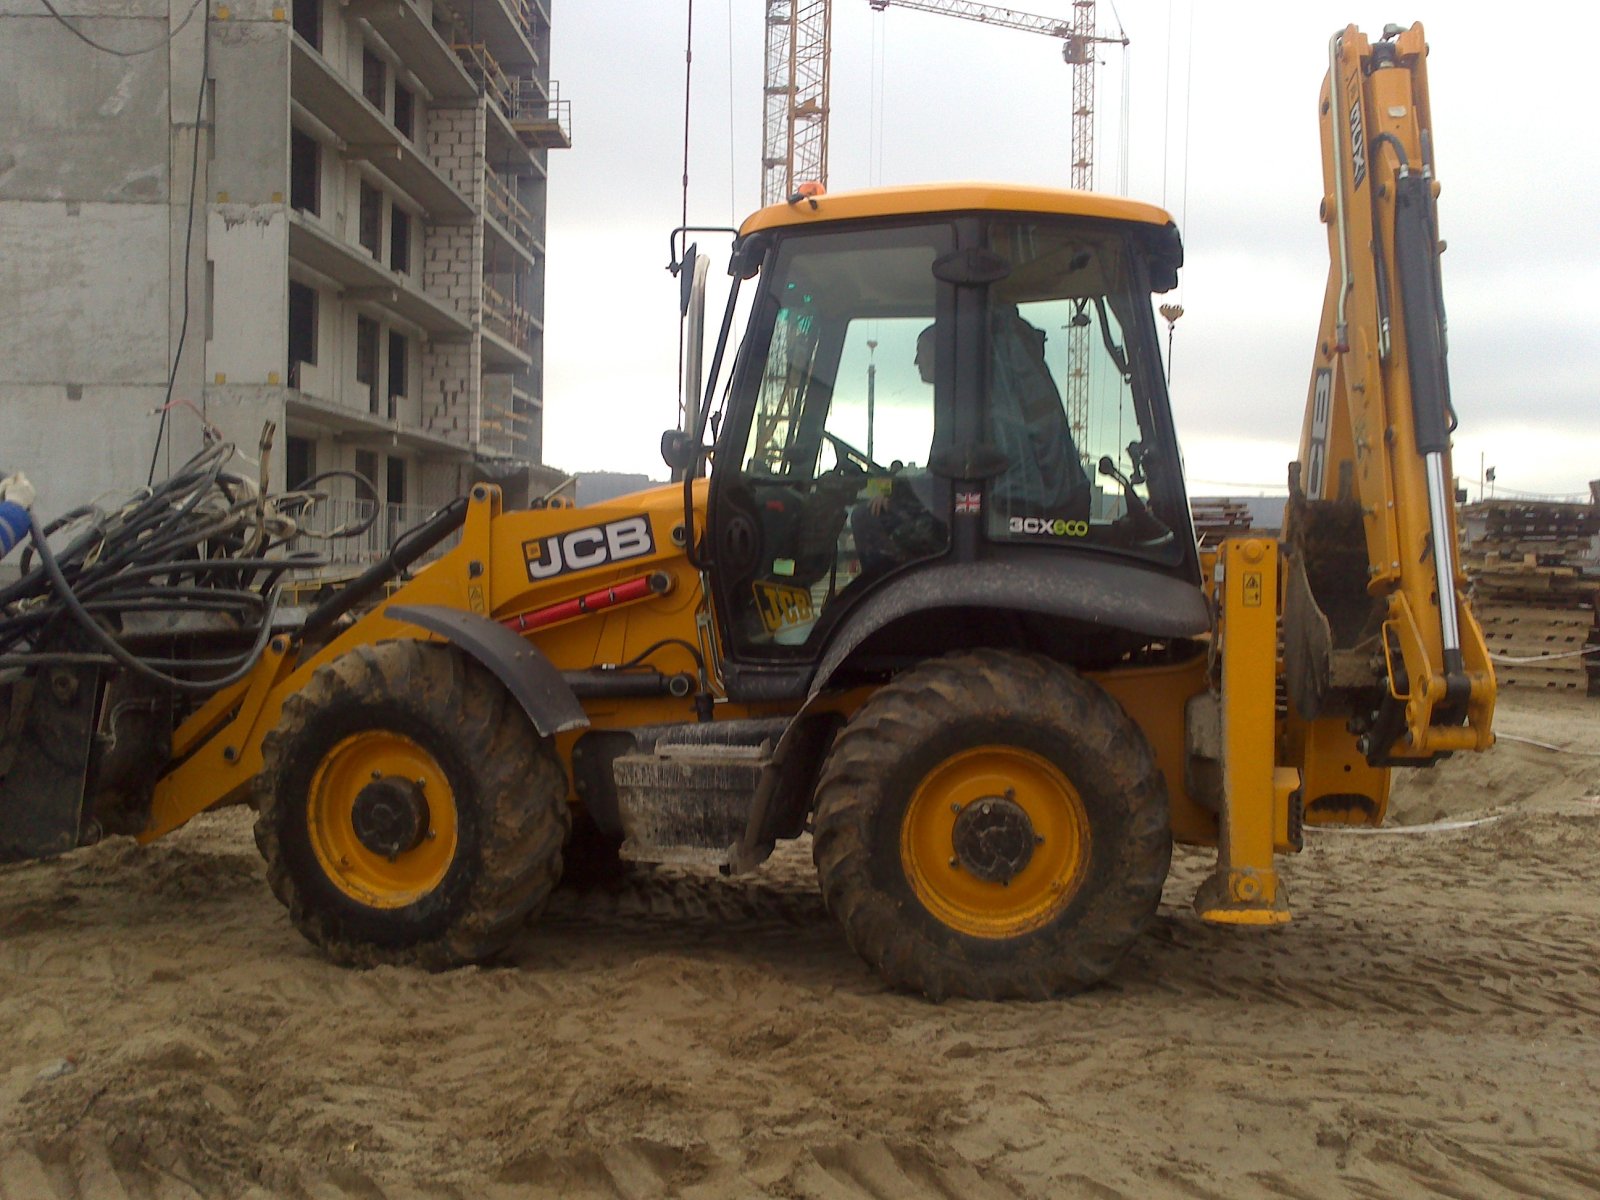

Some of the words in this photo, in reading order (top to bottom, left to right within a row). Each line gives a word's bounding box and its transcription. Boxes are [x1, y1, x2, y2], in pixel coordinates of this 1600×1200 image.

[1349, 100, 1365, 184] 3CX
[1306, 372, 1331, 500] CB
[529, 517, 651, 578] JCB
[763, 586, 814, 630] JCB
